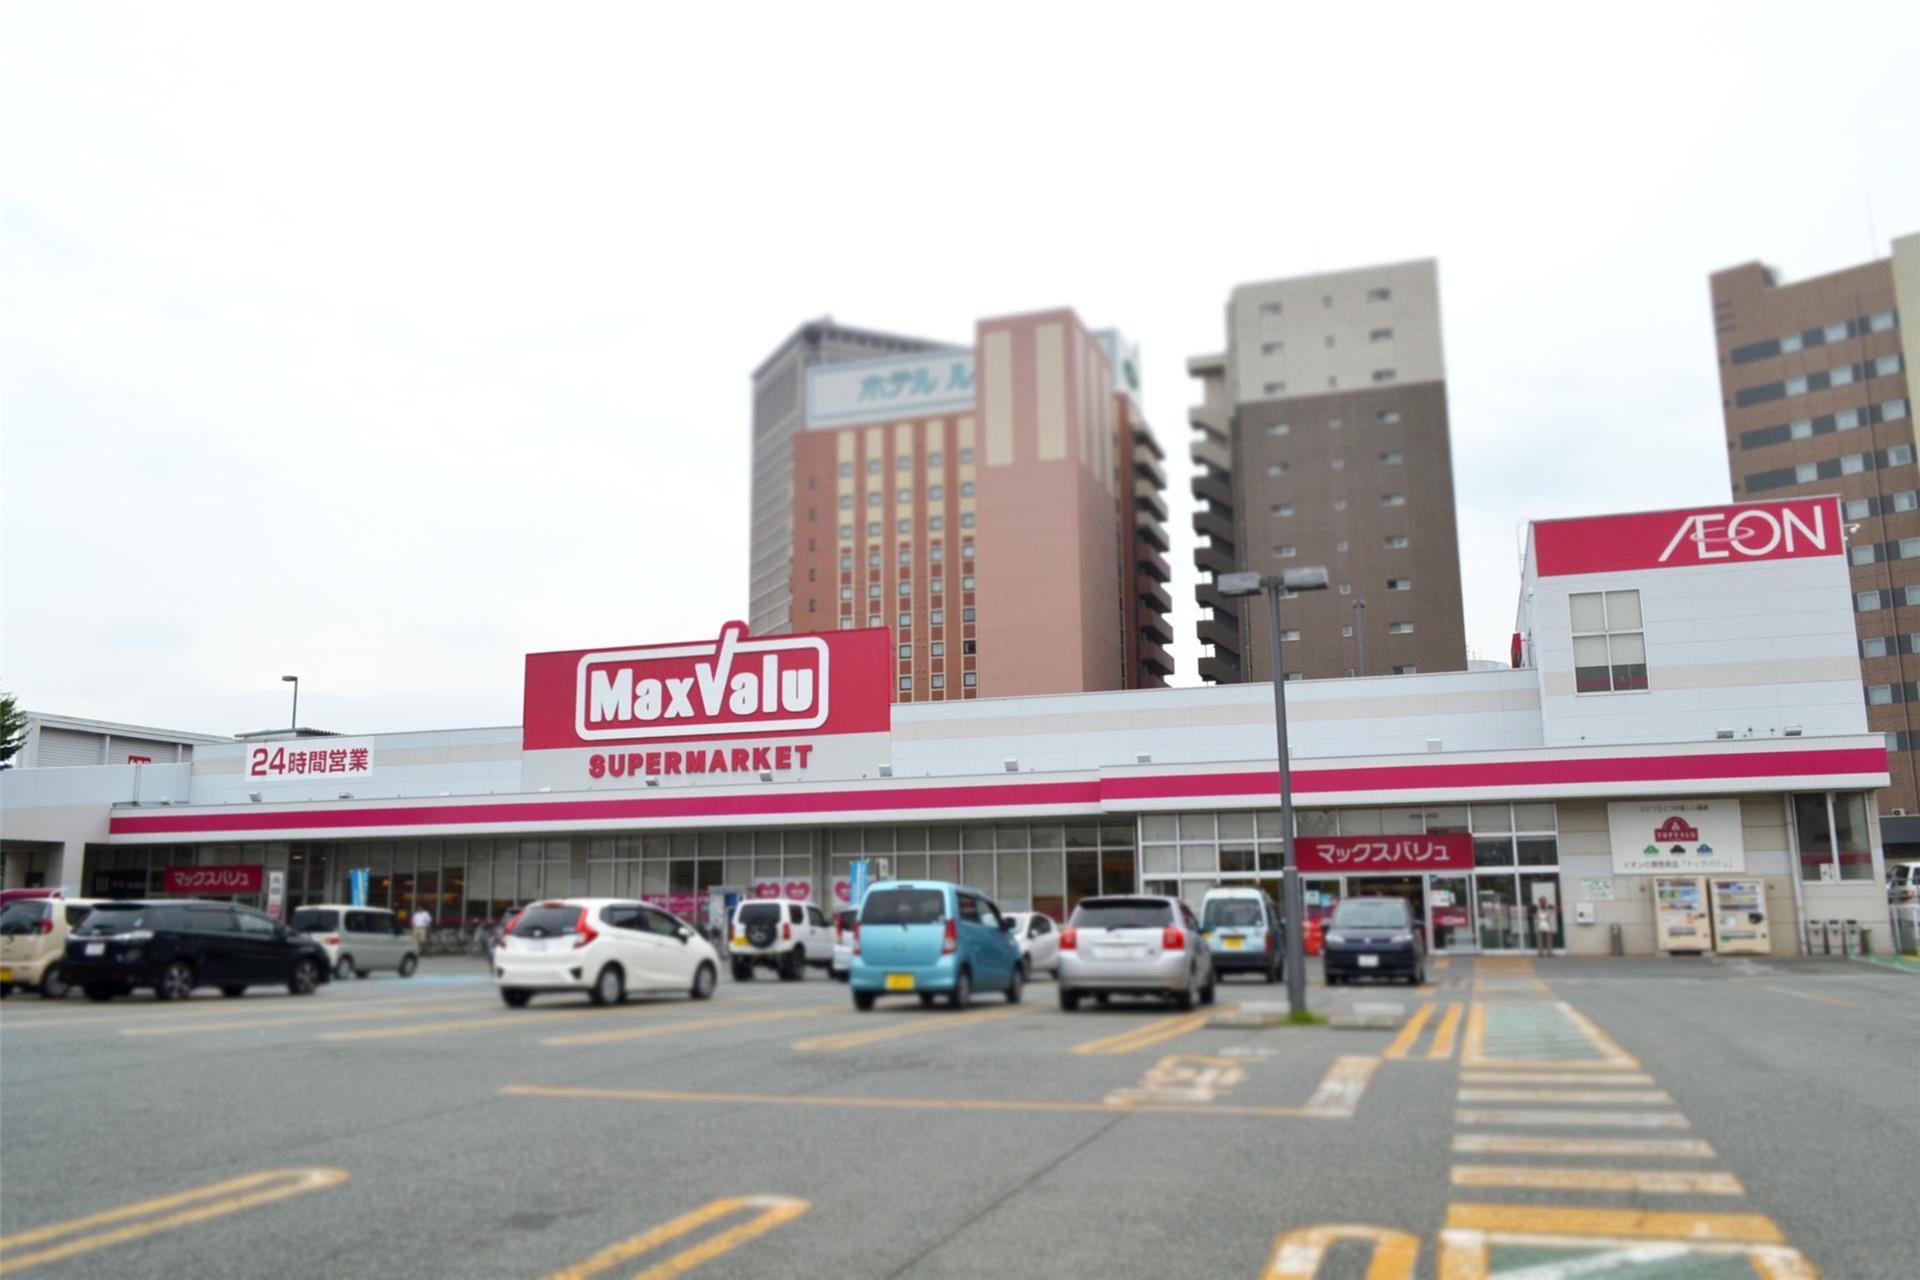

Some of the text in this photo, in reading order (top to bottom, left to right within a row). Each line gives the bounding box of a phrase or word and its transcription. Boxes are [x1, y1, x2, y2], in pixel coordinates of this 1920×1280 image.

[857, 368, 938, 403] ホテル
[590, 628, 813, 722] MaxValu
[250, 747, 369, 776] 24時間営業
[589, 745, 813, 778] SUPERMARKET
[1316, 842, 1451, 863] マックスバリュ
[173, 870, 251, 888] マックスバリュ
